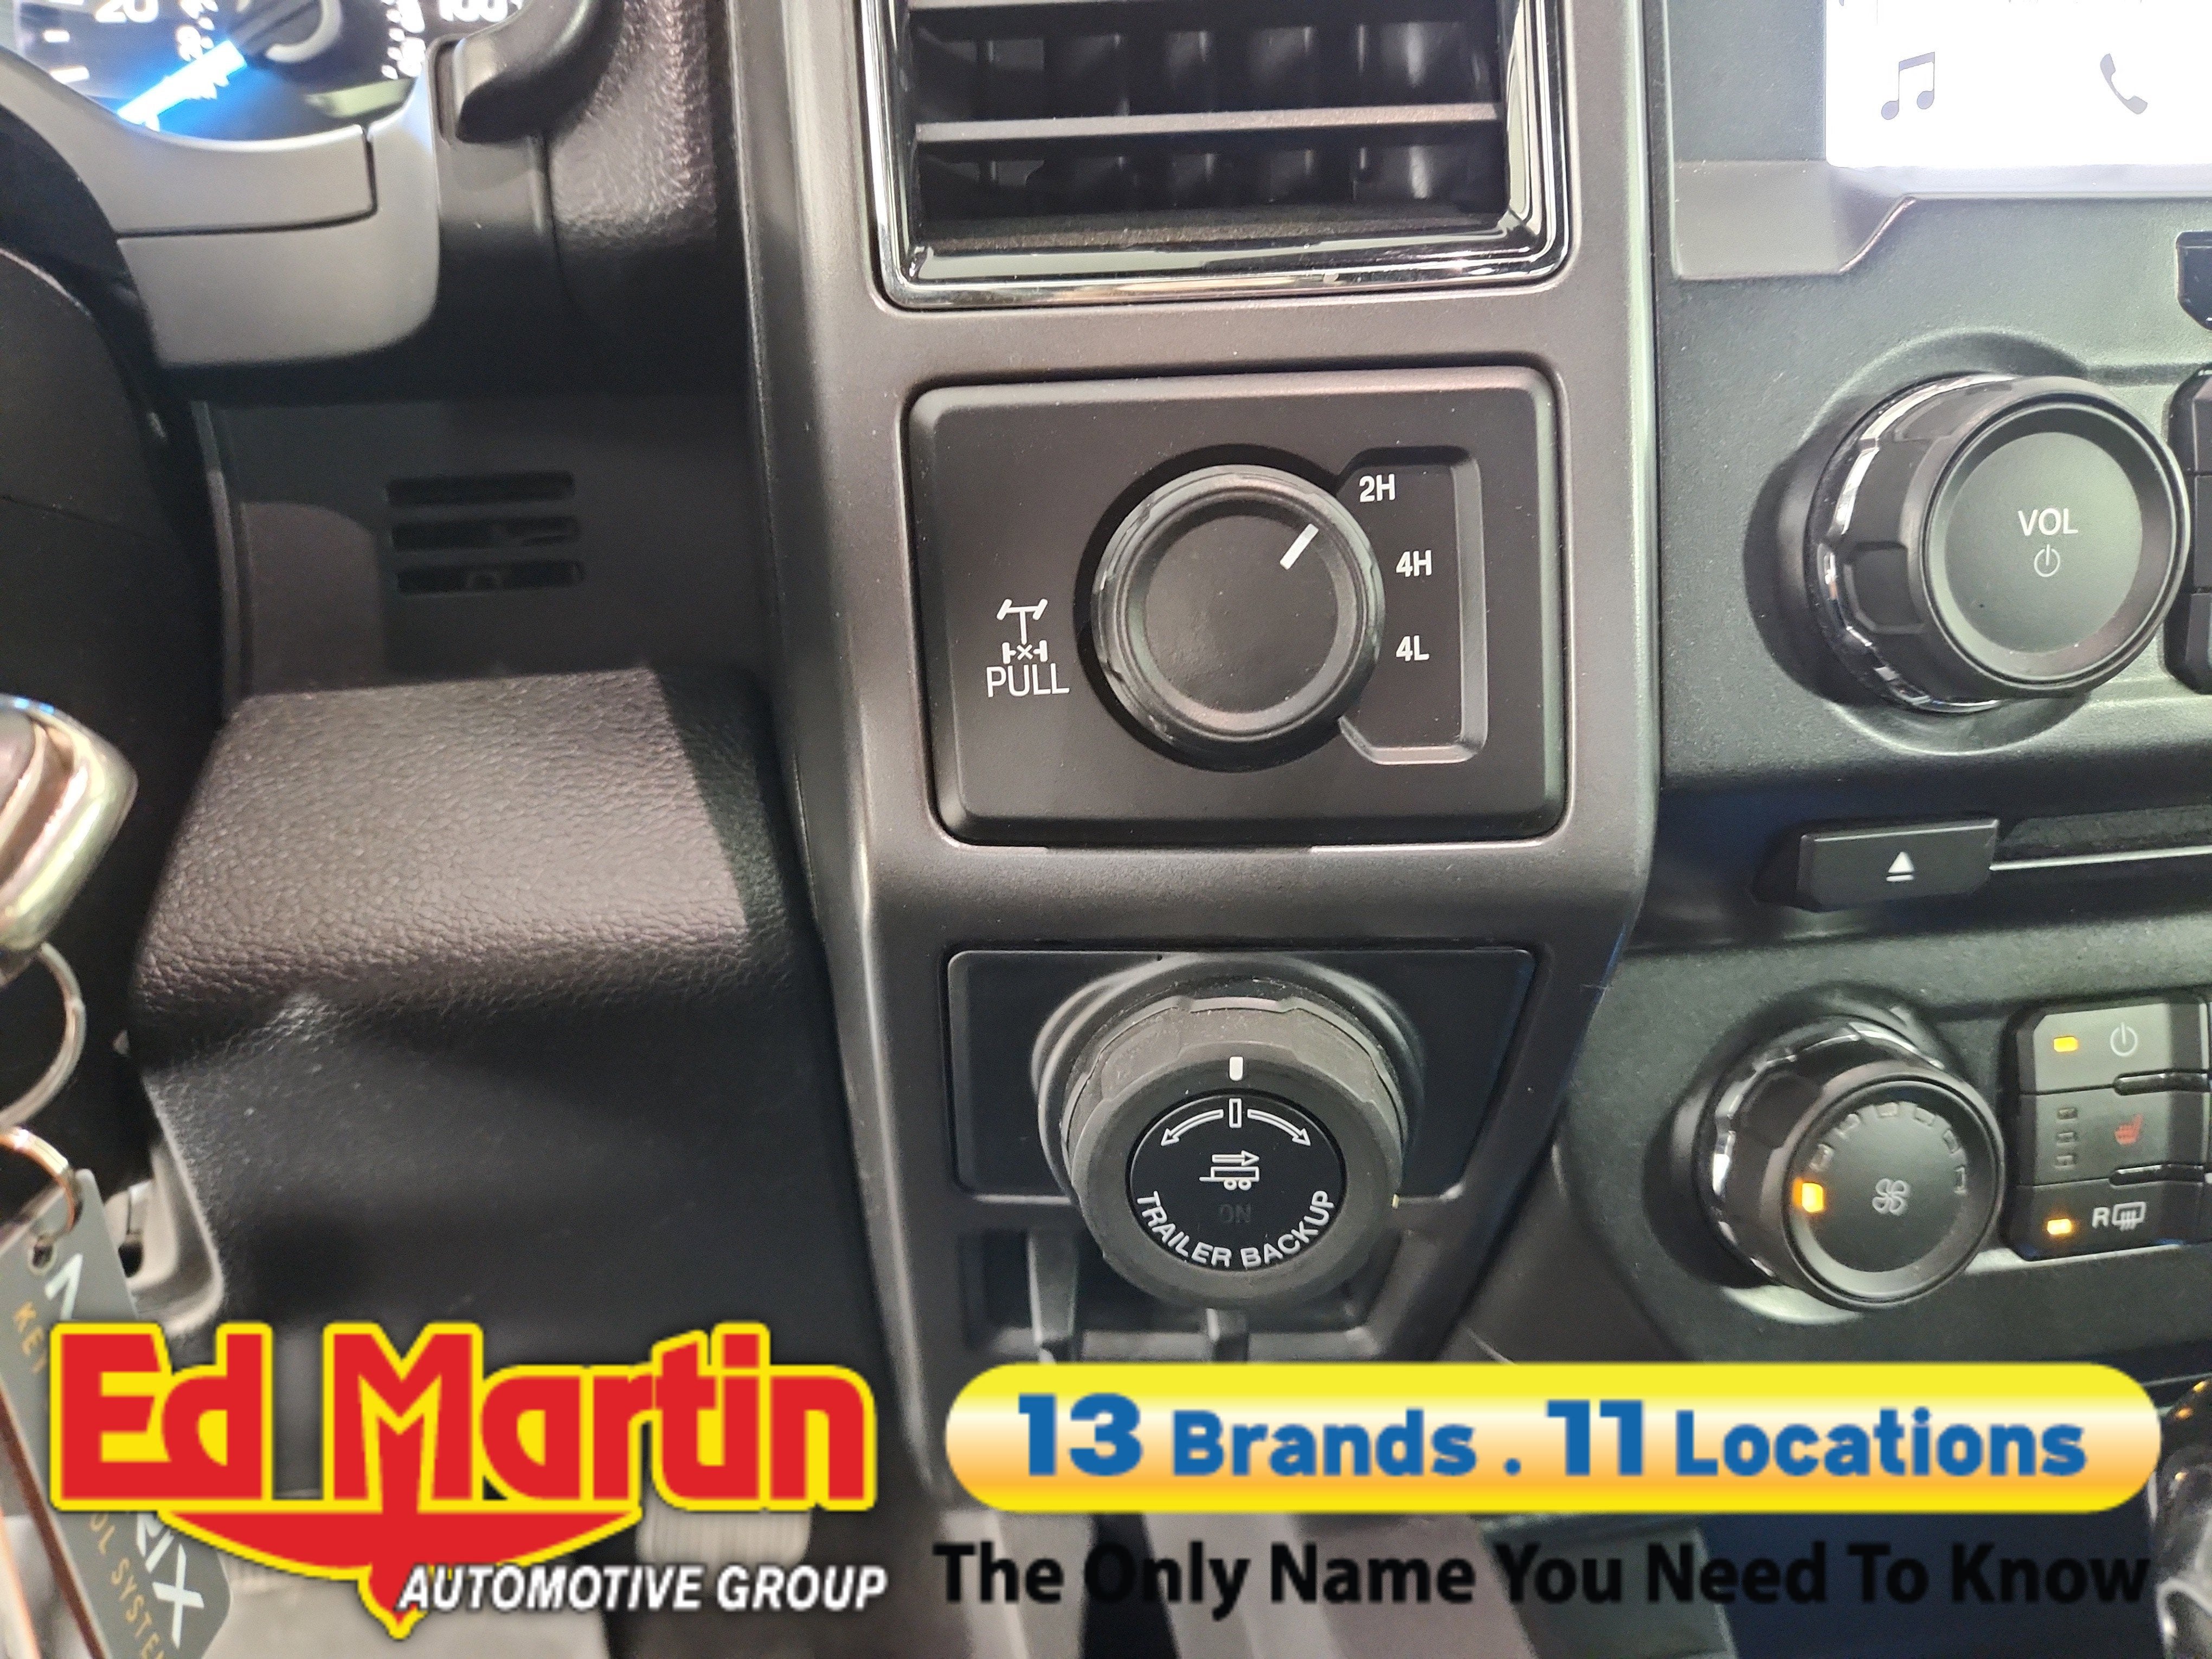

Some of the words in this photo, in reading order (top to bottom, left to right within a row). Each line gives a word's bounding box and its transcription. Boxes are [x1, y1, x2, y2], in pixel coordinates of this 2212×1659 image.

[1359, 473, 1396, 503] 2H
[2017, 507, 2079, 537] VOL
[1395, 550, 1432, 577] 4H
[1395, 635, 1430, 662] 4L
[986, 664, 1070, 698] PULL
[1137, 1191, 1232, 1268] TRAILER
[1240, 1190, 1336, 1268] BACKUP
[2092, 1206, 2110, 1229] R
